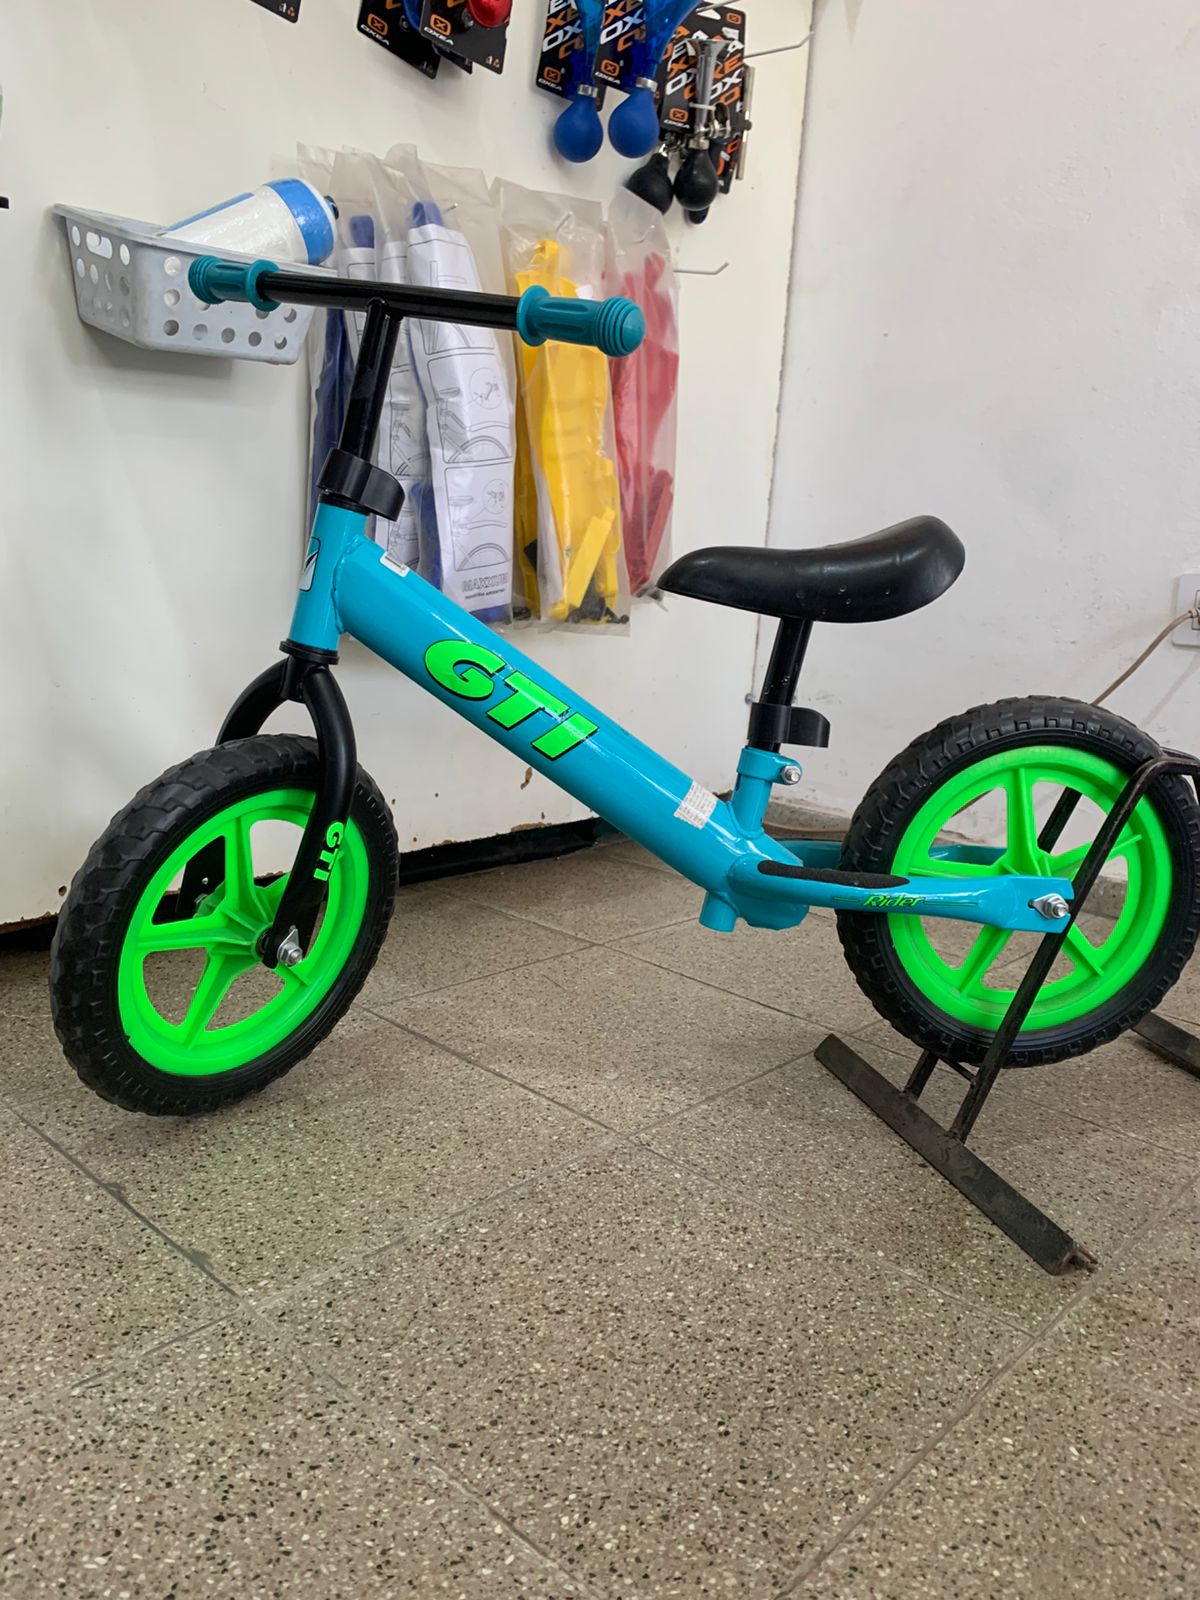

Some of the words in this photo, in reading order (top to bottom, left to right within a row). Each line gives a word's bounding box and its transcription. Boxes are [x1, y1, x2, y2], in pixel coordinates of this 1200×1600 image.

[423, 26, 454, 46] OXEA
[424, 639, 599, 761] GTI
[313, 821, 345, 882] GTI
[863, 895, 925, 907] Rider
